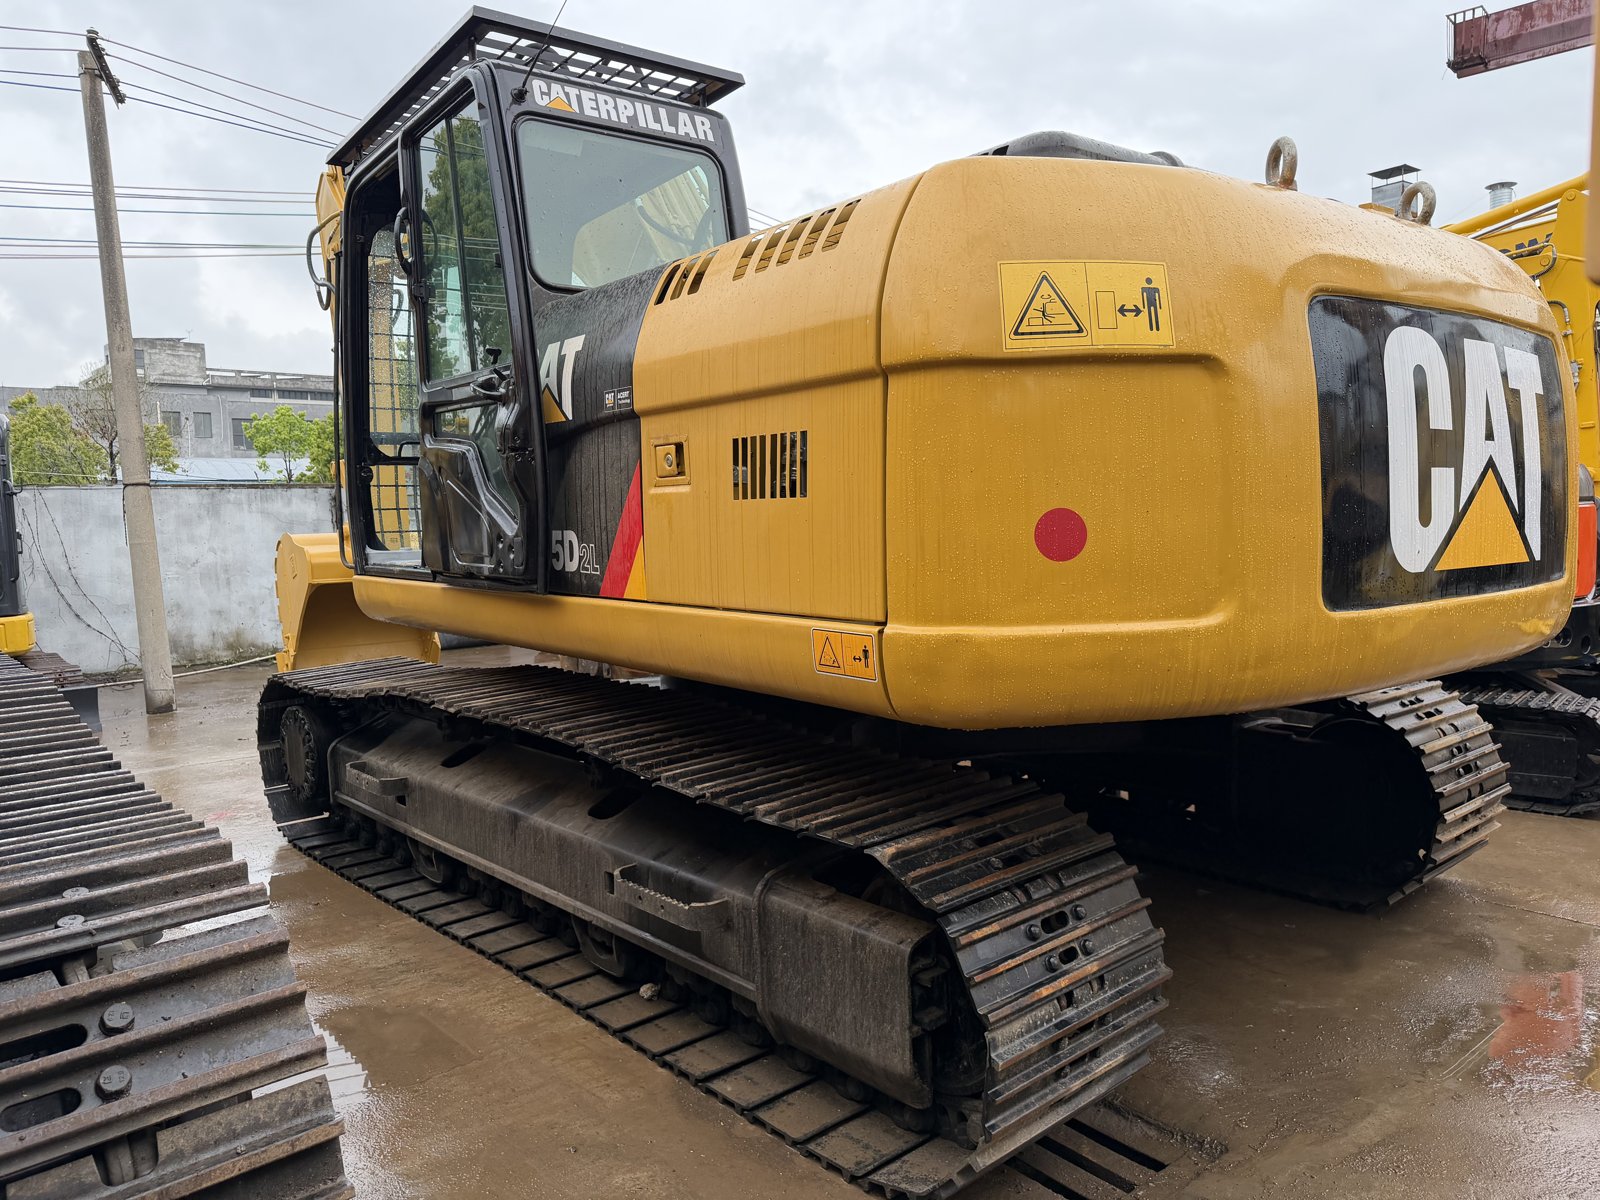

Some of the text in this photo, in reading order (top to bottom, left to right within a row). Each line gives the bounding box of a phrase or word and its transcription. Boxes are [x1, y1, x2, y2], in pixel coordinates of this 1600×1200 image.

[532, 79, 715, 142] CATERPILLAR
[537, 333, 586, 421] AT
[1384, 325, 1544, 574] CAT
